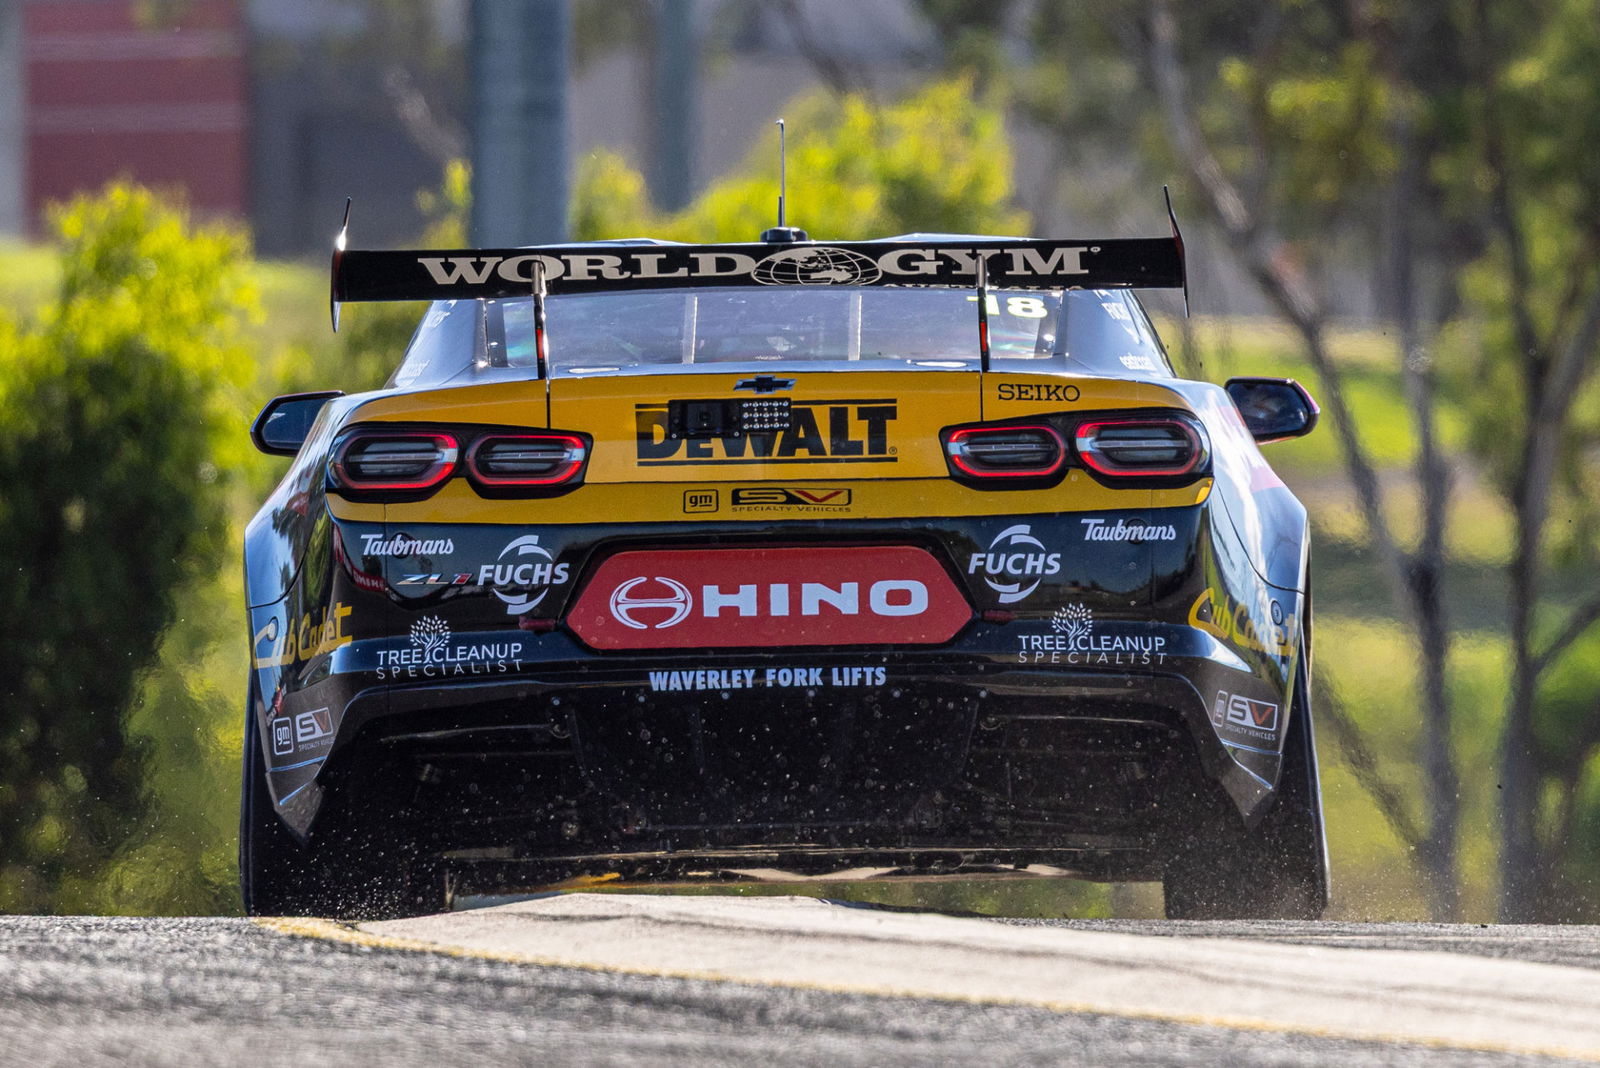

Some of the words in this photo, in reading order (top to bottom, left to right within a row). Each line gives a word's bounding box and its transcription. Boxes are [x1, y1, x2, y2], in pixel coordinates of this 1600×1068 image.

[417, 252, 755, 285] WORLD
[878, 246, 1090, 276] GYM
[967, 295, 1048, 319] 18
[997, 383, 1081, 403] SEIKO
[1081, 518, 1177, 542] Taubmans
[360, 533, 455, 556] Taubmans
[477, 562, 570, 586] FUCHS
[968, 552, 1062, 575] FUCHS
[396, 573, 474, 585] ZL1
[702, 579, 929, 618] HINO
[376, 649, 424, 666] TREE
[430, 642, 523, 663] CLEANUP
[1018, 635, 1067, 651] TREE
[1076, 636, 1166, 651] CLEANUP
[376, 658, 523, 680] SPECIALIST
[1018, 650, 1168, 665] SPECIALIST
[649, 670, 756, 691] WAVERLEY
[766, 667, 824, 687] FORK
[832, 667, 887, 687] LIFTS
